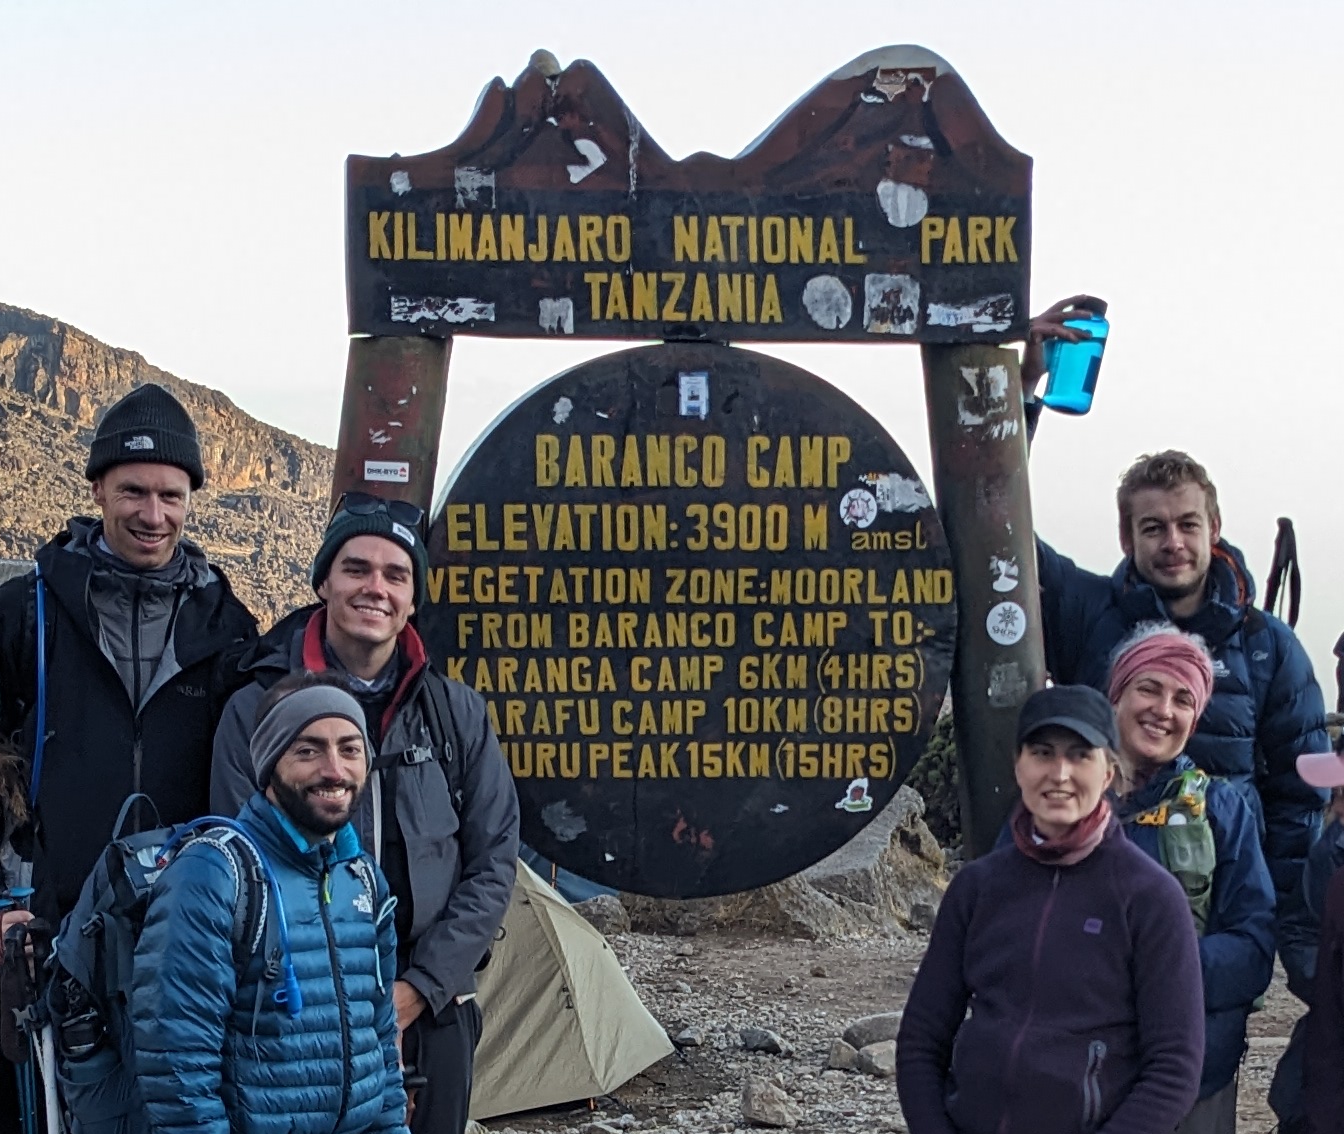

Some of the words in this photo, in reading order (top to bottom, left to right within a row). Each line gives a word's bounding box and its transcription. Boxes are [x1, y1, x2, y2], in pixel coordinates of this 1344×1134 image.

[368, 211, 632, 263] KILIMANJARO
[673, 215, 866, 264] NATIONAL
[920, 215, 1017, 263] PARK
[584, 271, 782, 322] TANZANIA
[535, 433, 726, 488] BARANCO
[746, 434, 852, 489] CAMP
[803, 503, 828, 549] M
[426, 565, 651, 605] VEGETATION
[458, 612, 553, 649] FROM
[568, 612, 736, 649] BARANCO
[753, 611, 848, 647] CAMP
[447, 656, 617, 693] KARANGA
[630, 654, 724, 692] CAMP
[488, 698, 600, 736] ARAFU
[612, 699, 706, 735] CAMP
[589, 741, 680, 778] PEAK
